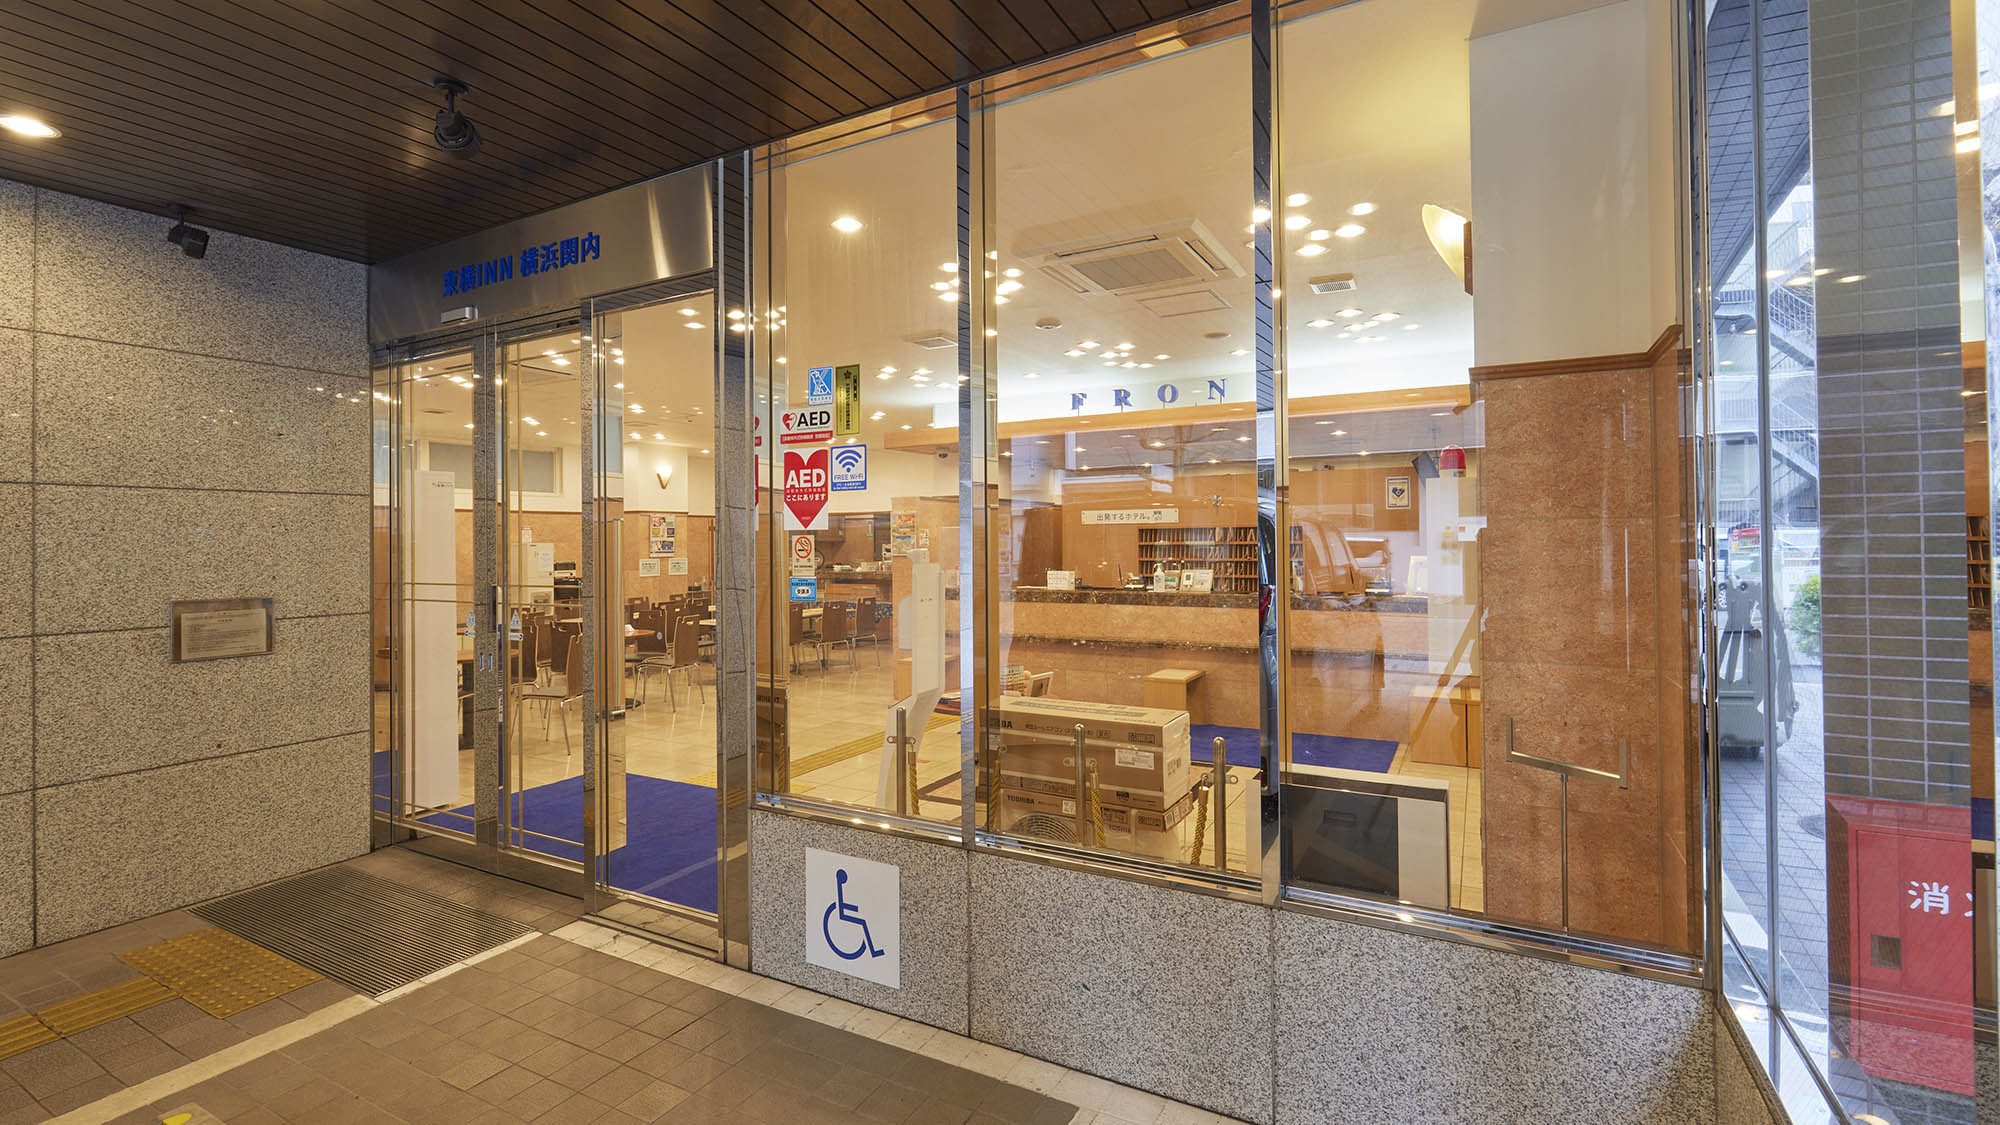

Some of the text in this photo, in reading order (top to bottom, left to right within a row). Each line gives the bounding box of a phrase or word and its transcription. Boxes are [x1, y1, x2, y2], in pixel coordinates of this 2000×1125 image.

[442, 232, 601, 297] 東横INN 横浜関内
[797, 411, 831, 427] AED
[785, 468, 826, 488] AED
[786, 493, 826, 502] ここにあります
